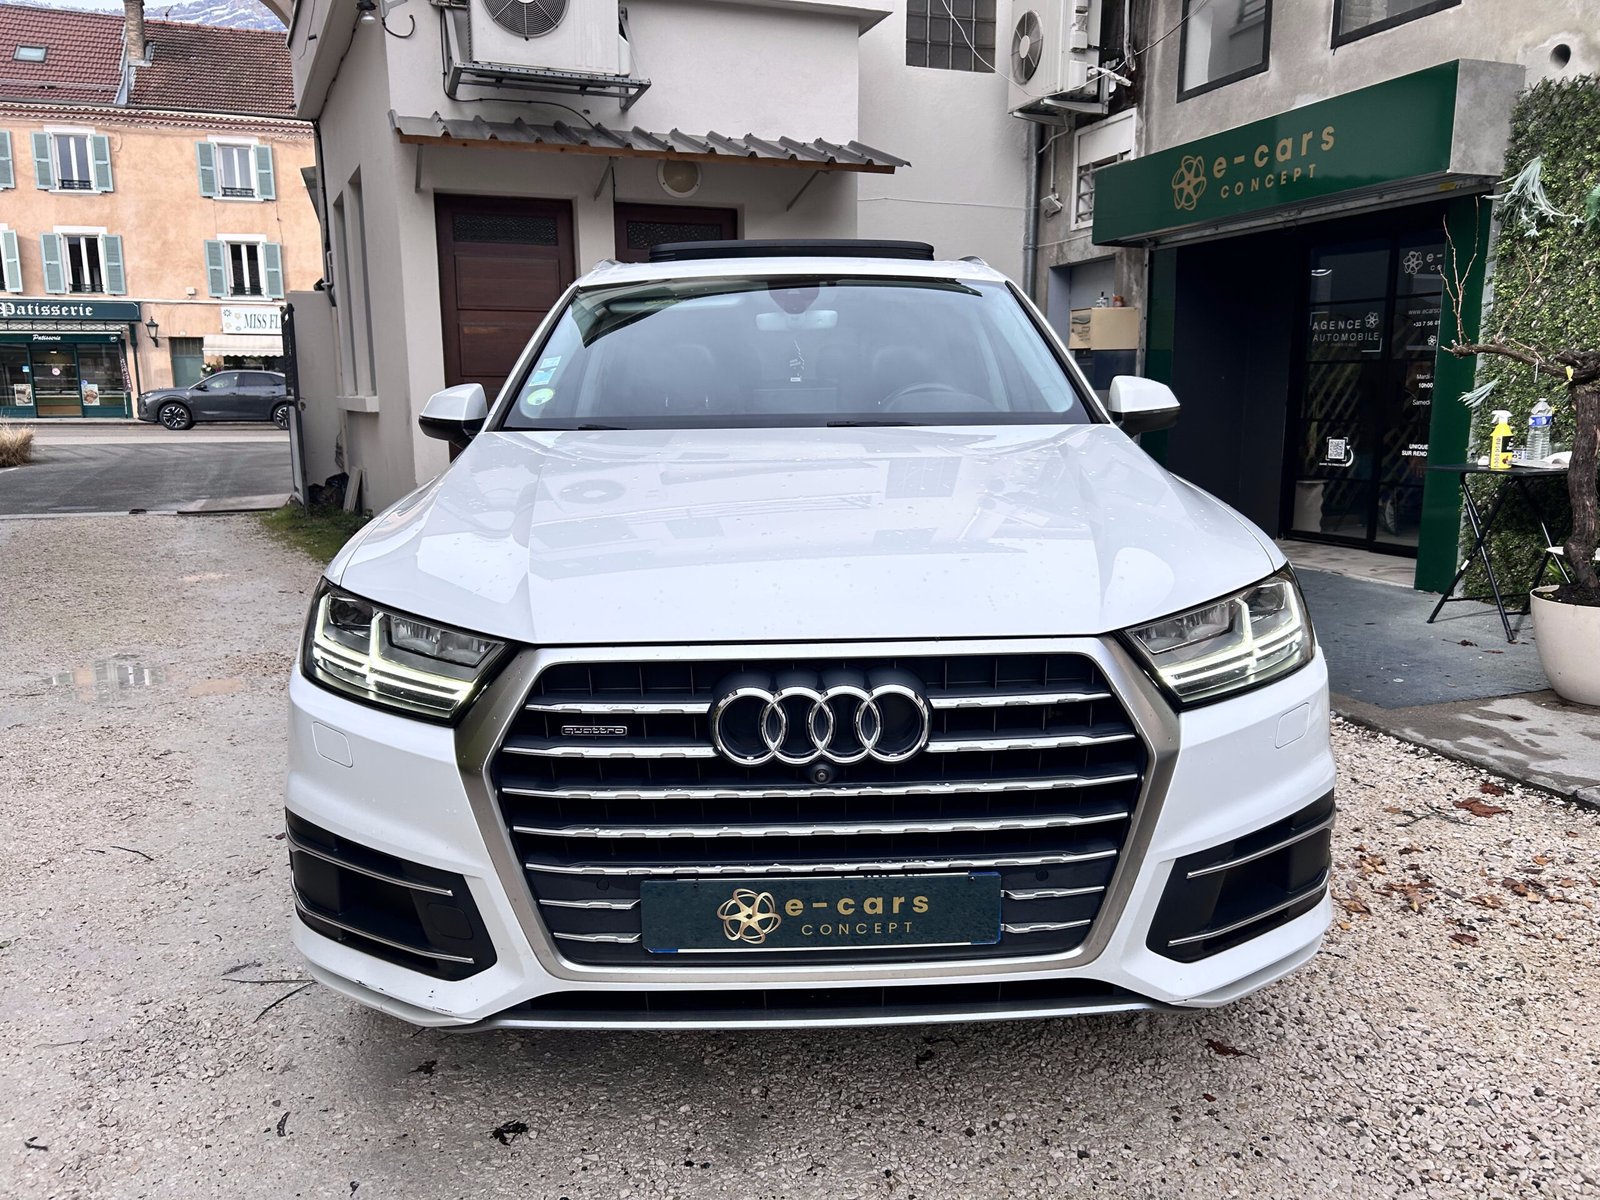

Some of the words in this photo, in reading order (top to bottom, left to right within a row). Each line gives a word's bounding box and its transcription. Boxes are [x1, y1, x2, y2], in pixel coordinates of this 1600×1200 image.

[1213, 126, 1335, 179] e-cars
[1220, 163, 1317, 198] CONCEPT
[0, 302, 94, 317] Patisserie
[244, 313, 267, 329] MISS
[1312, 319, 1361, 330] AGENCE
[1312, 332, 1380, 342] AUTOMOBILE
[564, 727, 624, 735] quattro
[784, 895, 929, 916] e-cars
[801, 921, 912, 935] CONCEPT
